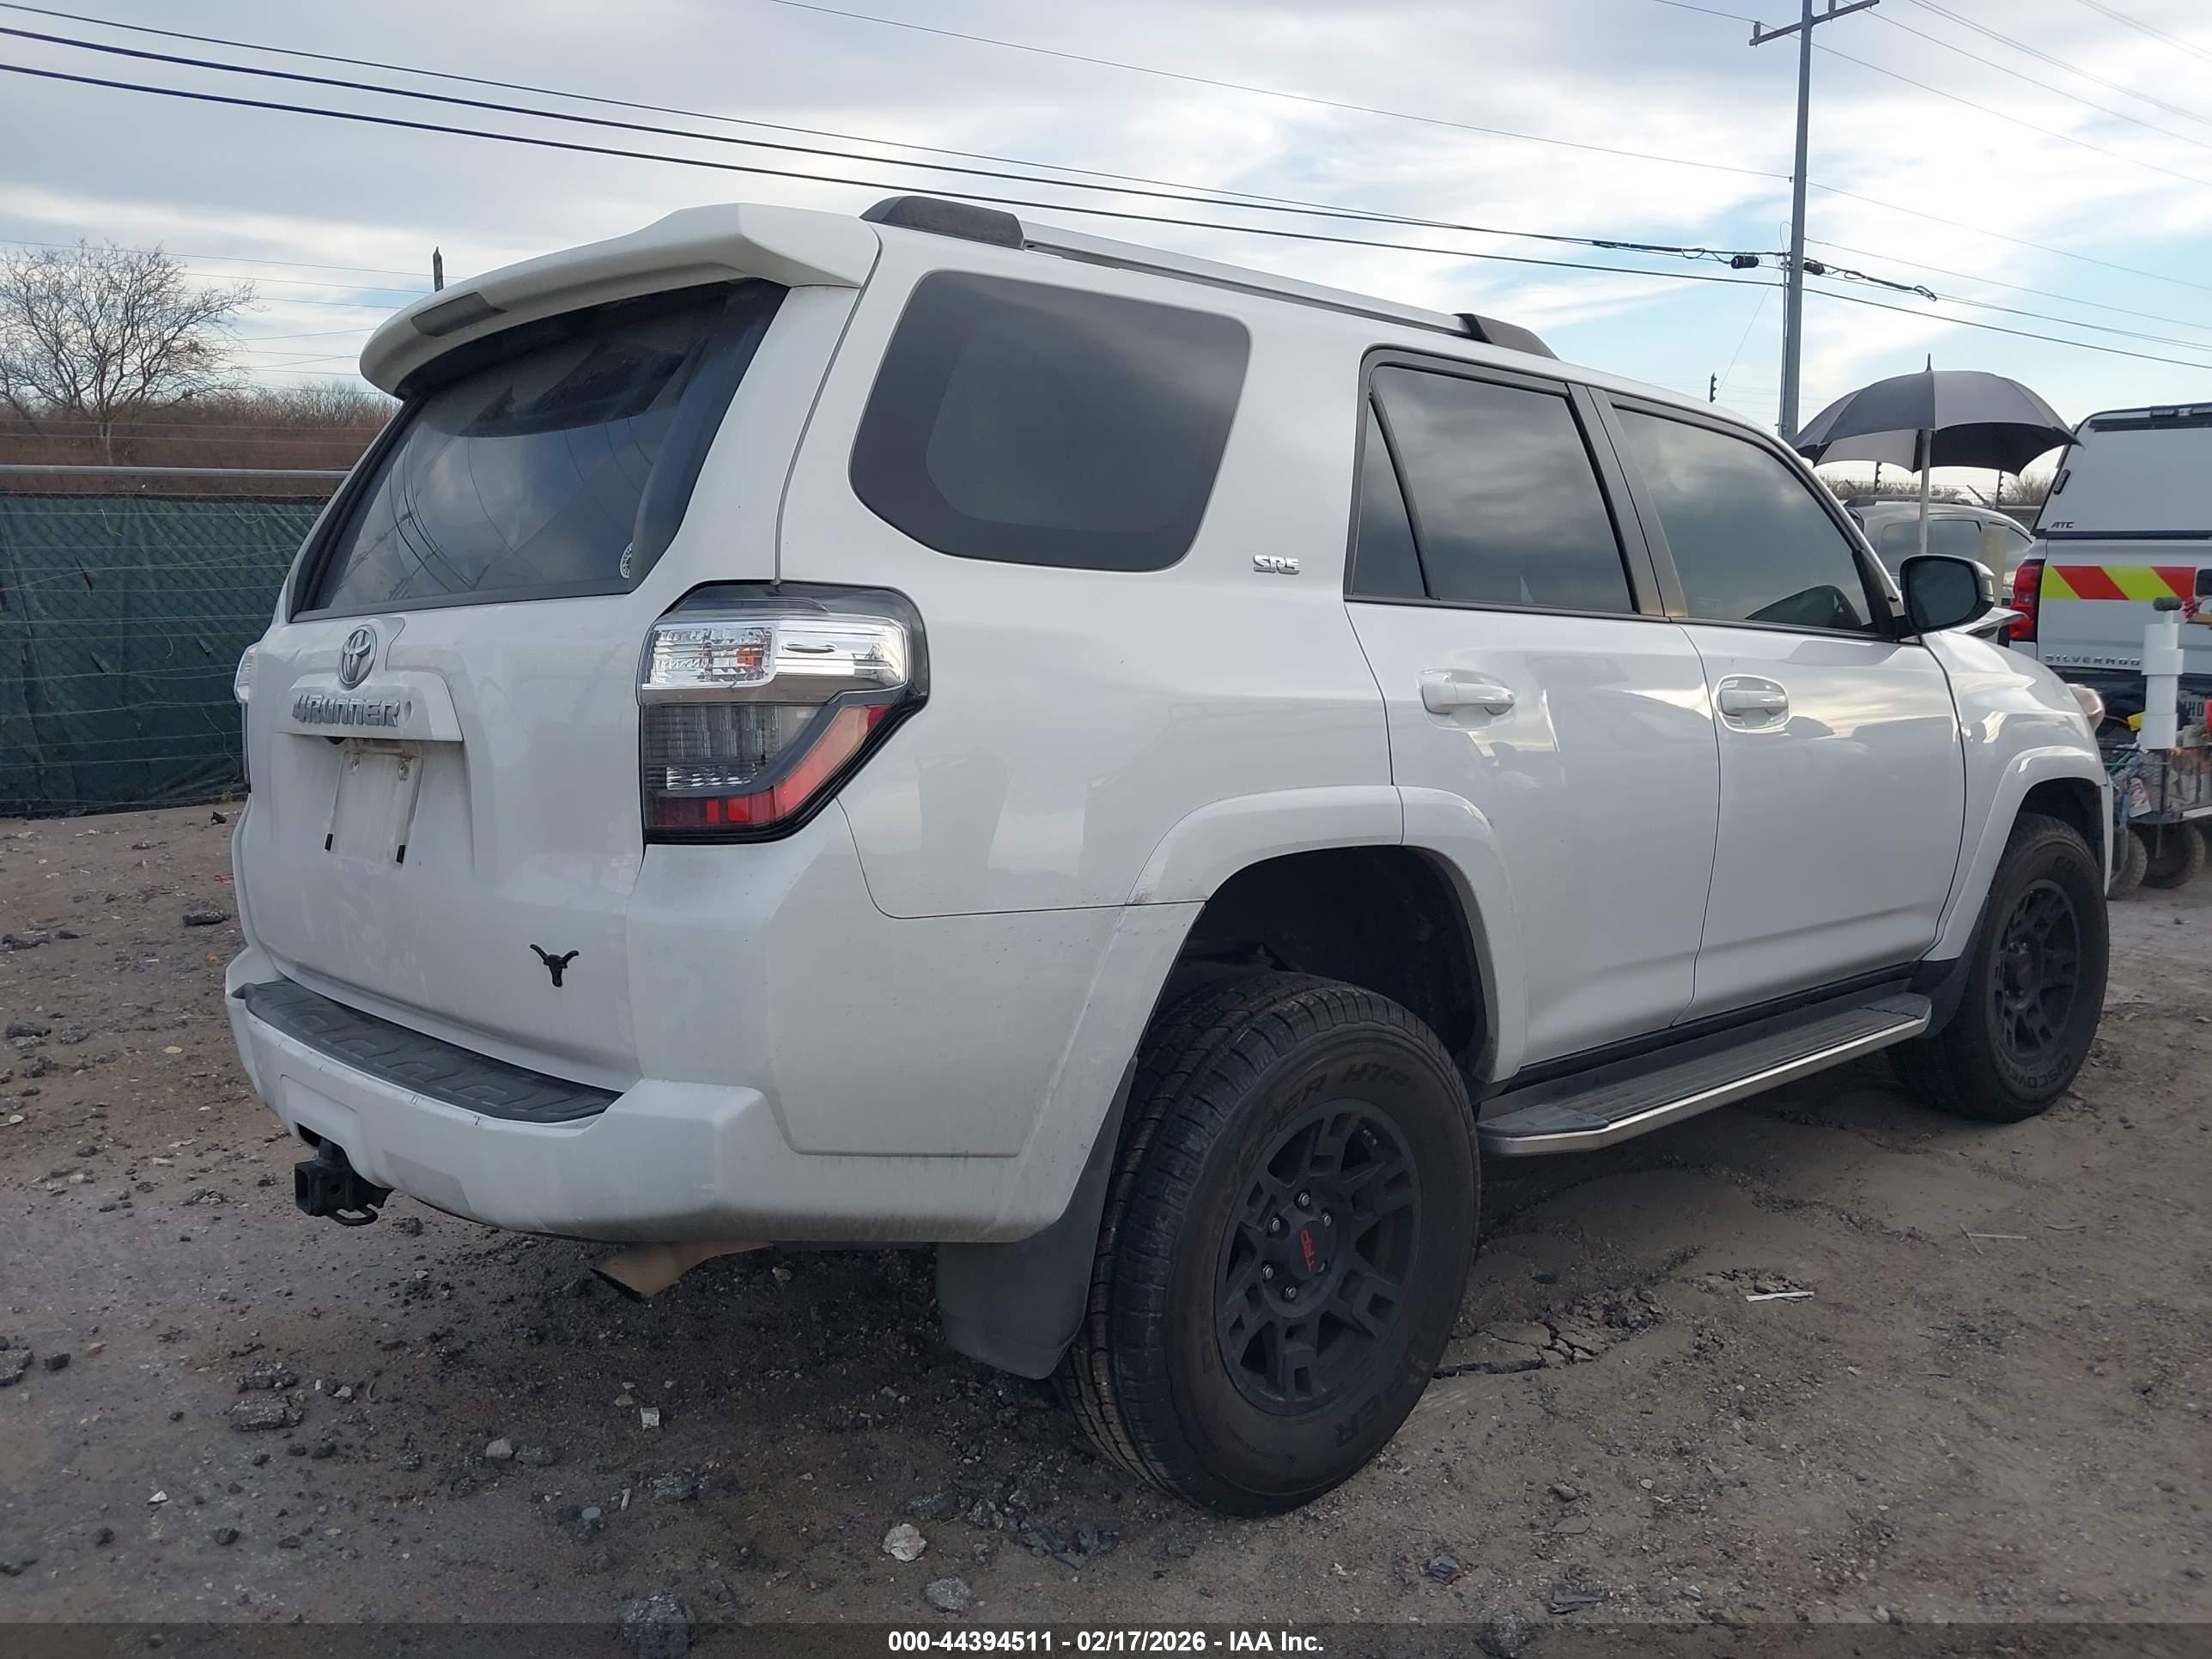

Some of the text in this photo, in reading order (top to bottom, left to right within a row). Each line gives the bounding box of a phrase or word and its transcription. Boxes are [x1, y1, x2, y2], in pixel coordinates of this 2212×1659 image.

[1253, 555, 1300, 574] SR5
[2045, 653, 2142, 666] SILVERADO
[291, 694, 400, 727] 4RUNNER
